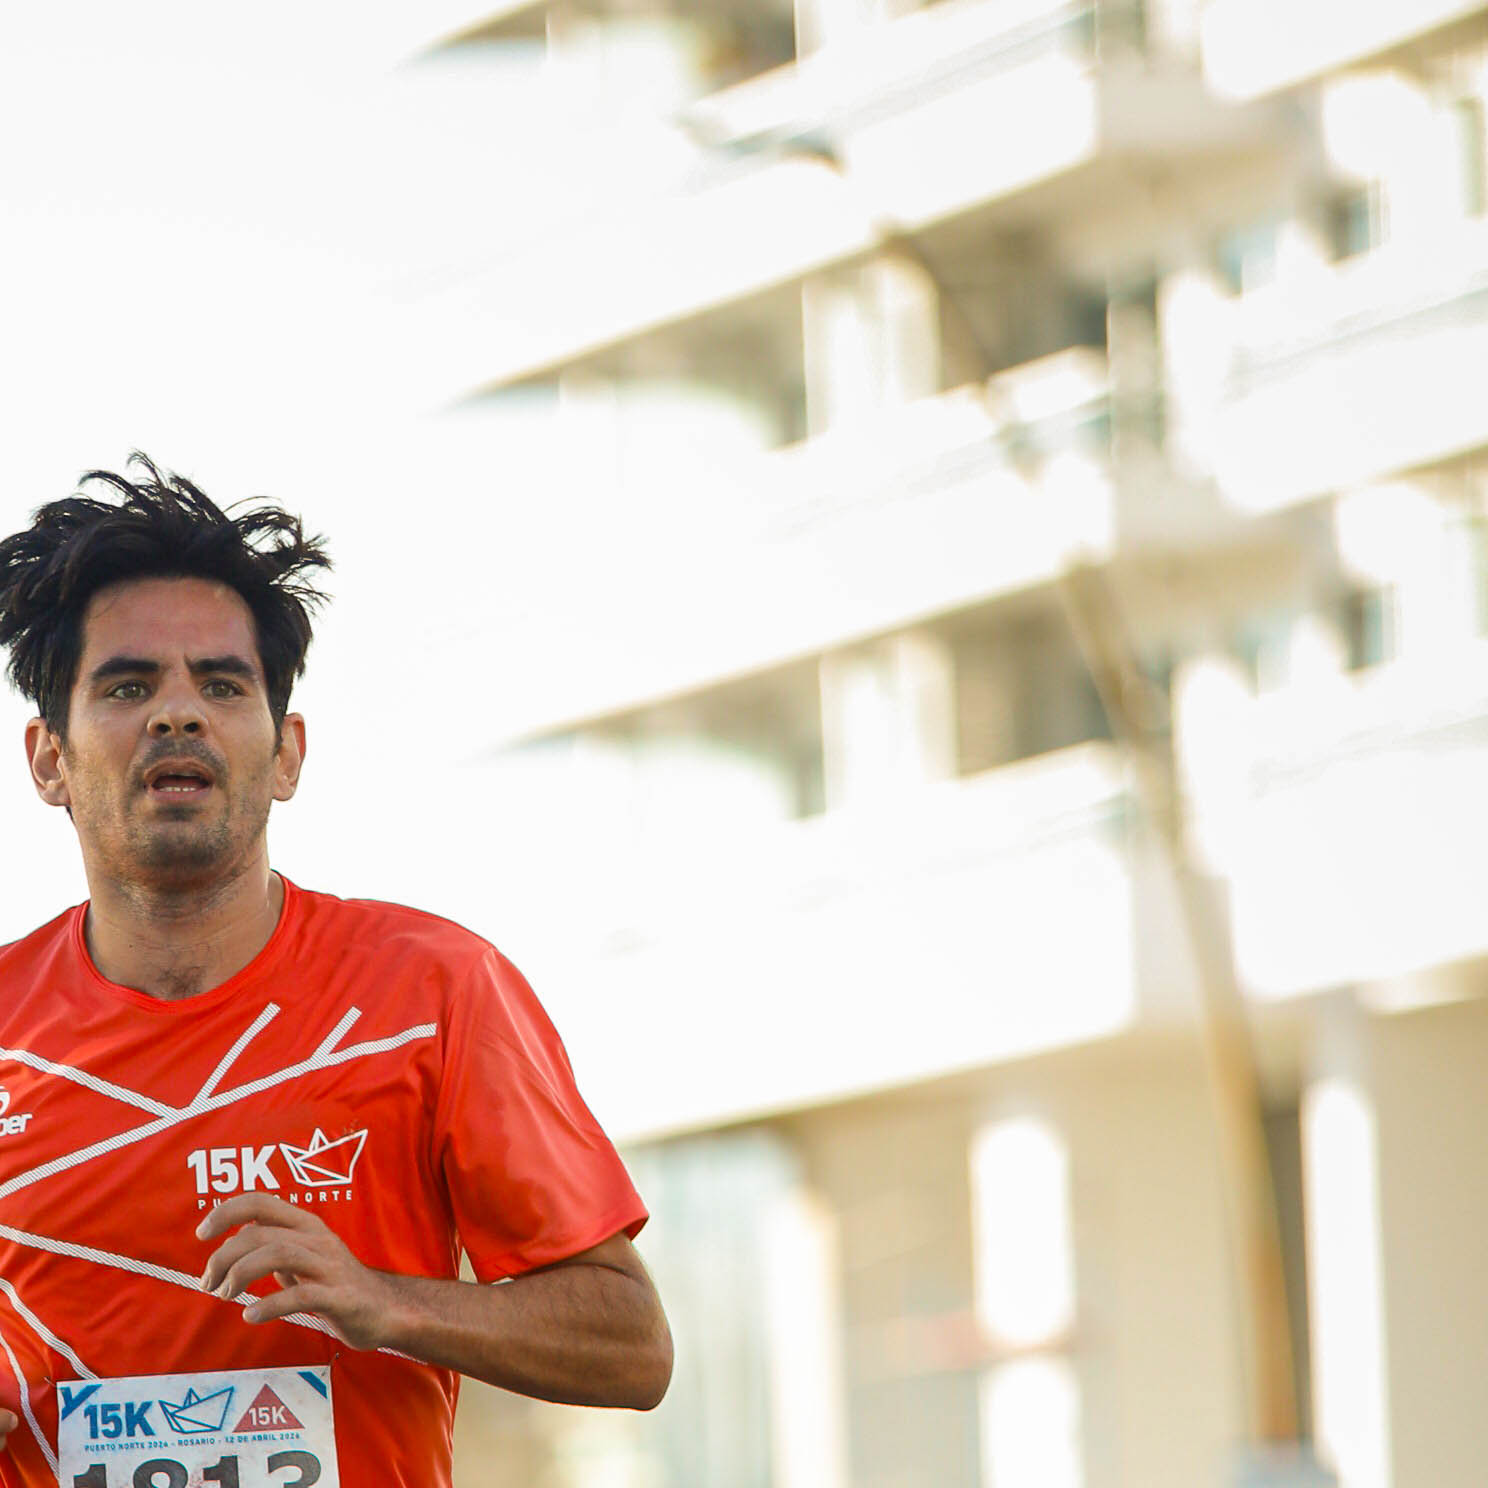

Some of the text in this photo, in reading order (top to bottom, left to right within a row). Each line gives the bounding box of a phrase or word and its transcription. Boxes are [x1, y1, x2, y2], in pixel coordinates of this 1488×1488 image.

[187, 1145, 280, 1194] 15K
[290, 1190, 353, 1204] NORTE
[84, 1401, 155, 1439] 15K
[249, 1404, 287, 1426] 15K
[84, 1442, 116, 1451] PUERTO
[118, 1441, 145, 1449] NORTE
[177, 1437, 215, 1447] ROSARIO
[225, 1435, 234, 1444] 12
[238, 1435, 249, 1443] DE
[252, 1433, 277, 1442] ABRIL
